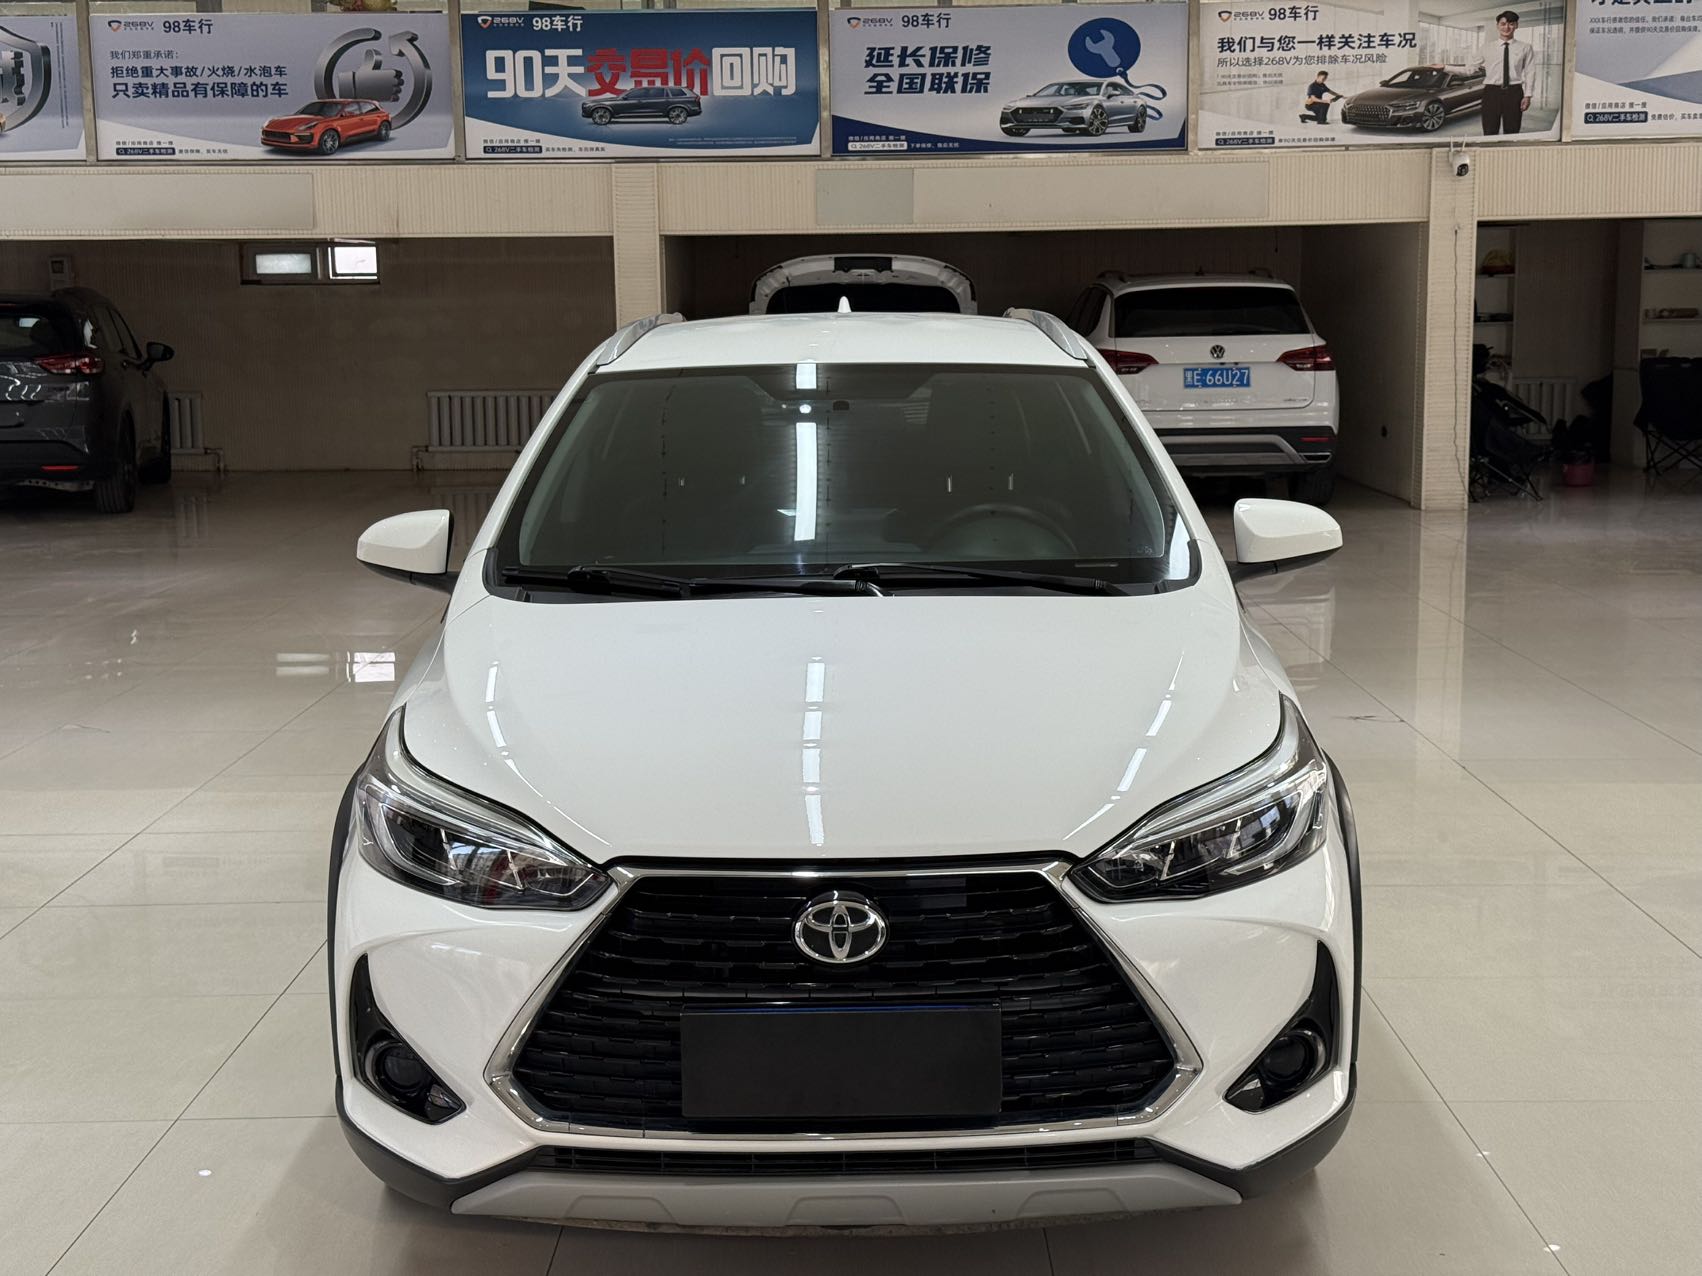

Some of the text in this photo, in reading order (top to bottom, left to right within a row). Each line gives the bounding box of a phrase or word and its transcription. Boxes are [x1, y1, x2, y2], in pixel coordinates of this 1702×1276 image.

[901, 12, 952, 29] 98车行
[1268, 5, 1319, 21] 98车行
[162, 18, 213, 35] 98车行
[532, 15, 583, 32] 98车行
[1217, 32, 1417, 54] 我们与您一样关注车况
[864, 44, 992, 69] 延长保修
[1216, 53, 1387, 68] 所以选择268V为您排除车况风险
[110, 65, 288, 79] 拒绝重大事故/火烧/水泡车
[485, 46, 797, 98] 90天交易价回购
[111, 81, 289, 99] 只卖精品有保障的车
[864, 71, 992, 95] 全国联保
